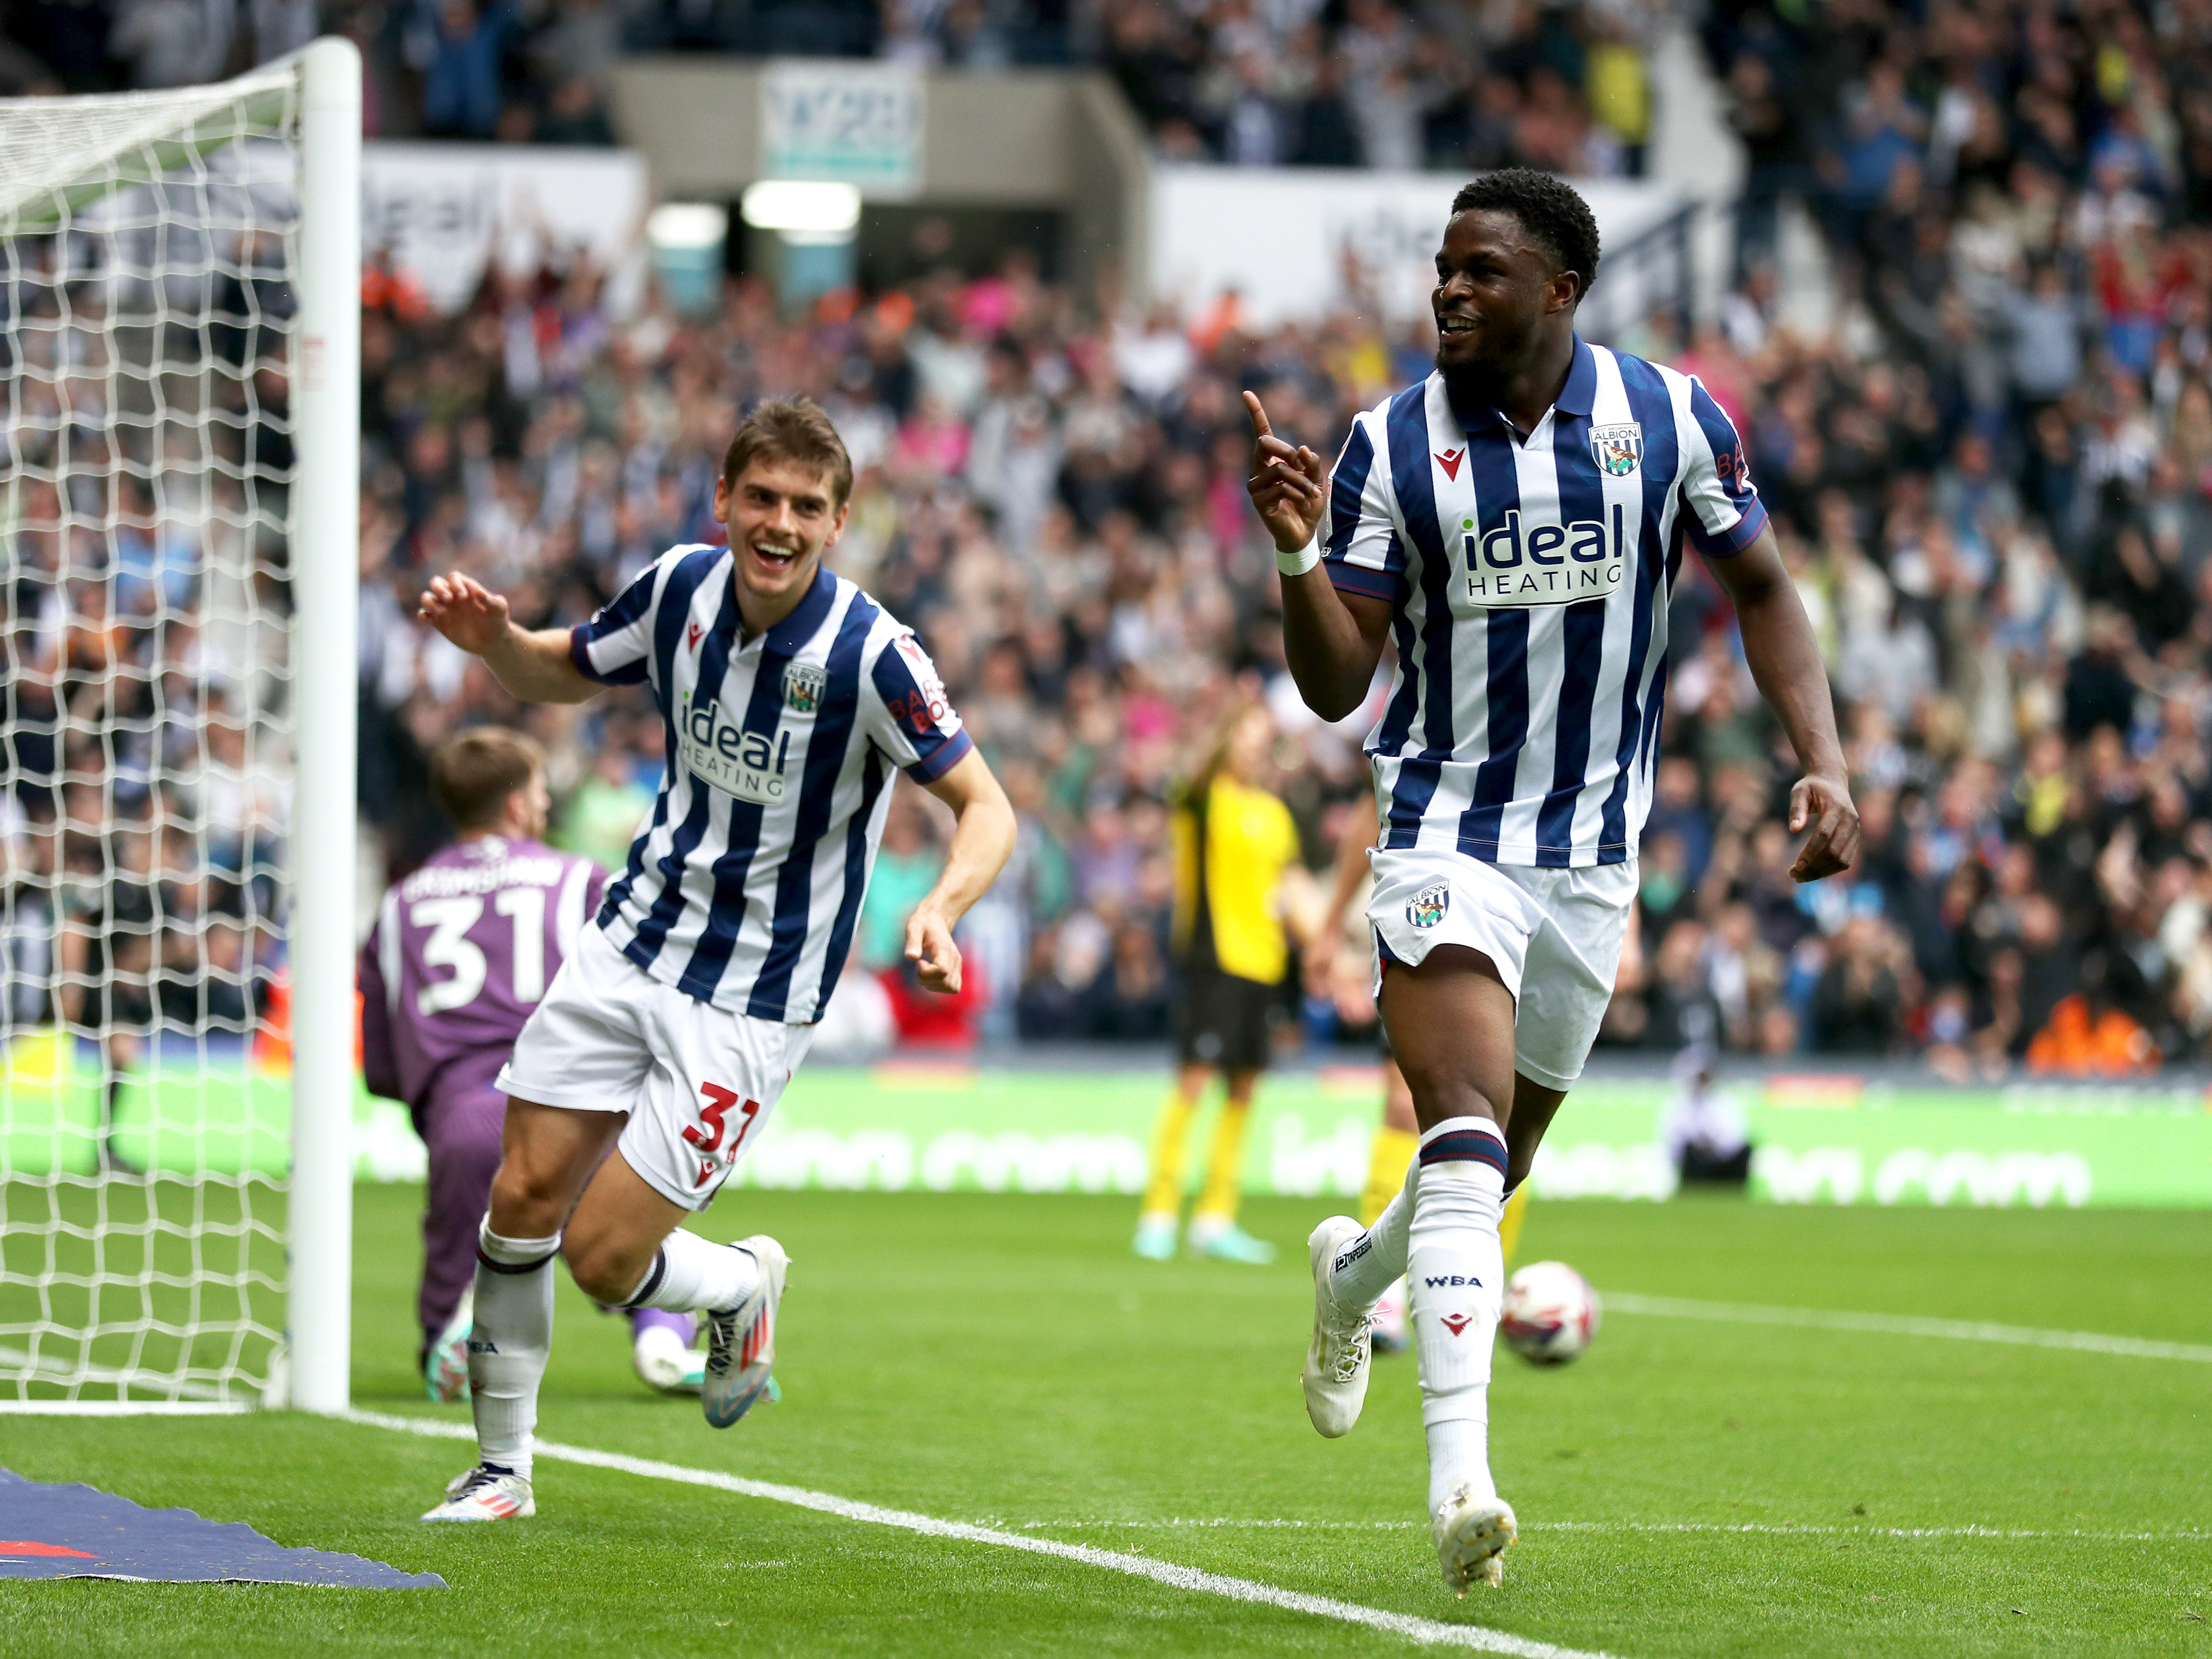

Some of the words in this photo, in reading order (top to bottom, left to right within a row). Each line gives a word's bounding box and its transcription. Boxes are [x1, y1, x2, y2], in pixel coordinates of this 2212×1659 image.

[1594, 429, 1637, 441] ALBION
[1463, 503, 1625, 571] ideal
[1468, 564, 1621, 597] HEATING
[683, 690, 790, 775] ideal
[681, 740, 783, 796] HEATING
[1408, 884, 1446, 907] ALBION
[410, 887, 546, 1017] 31
[1426, 1275, 1483, 1288] WBA
